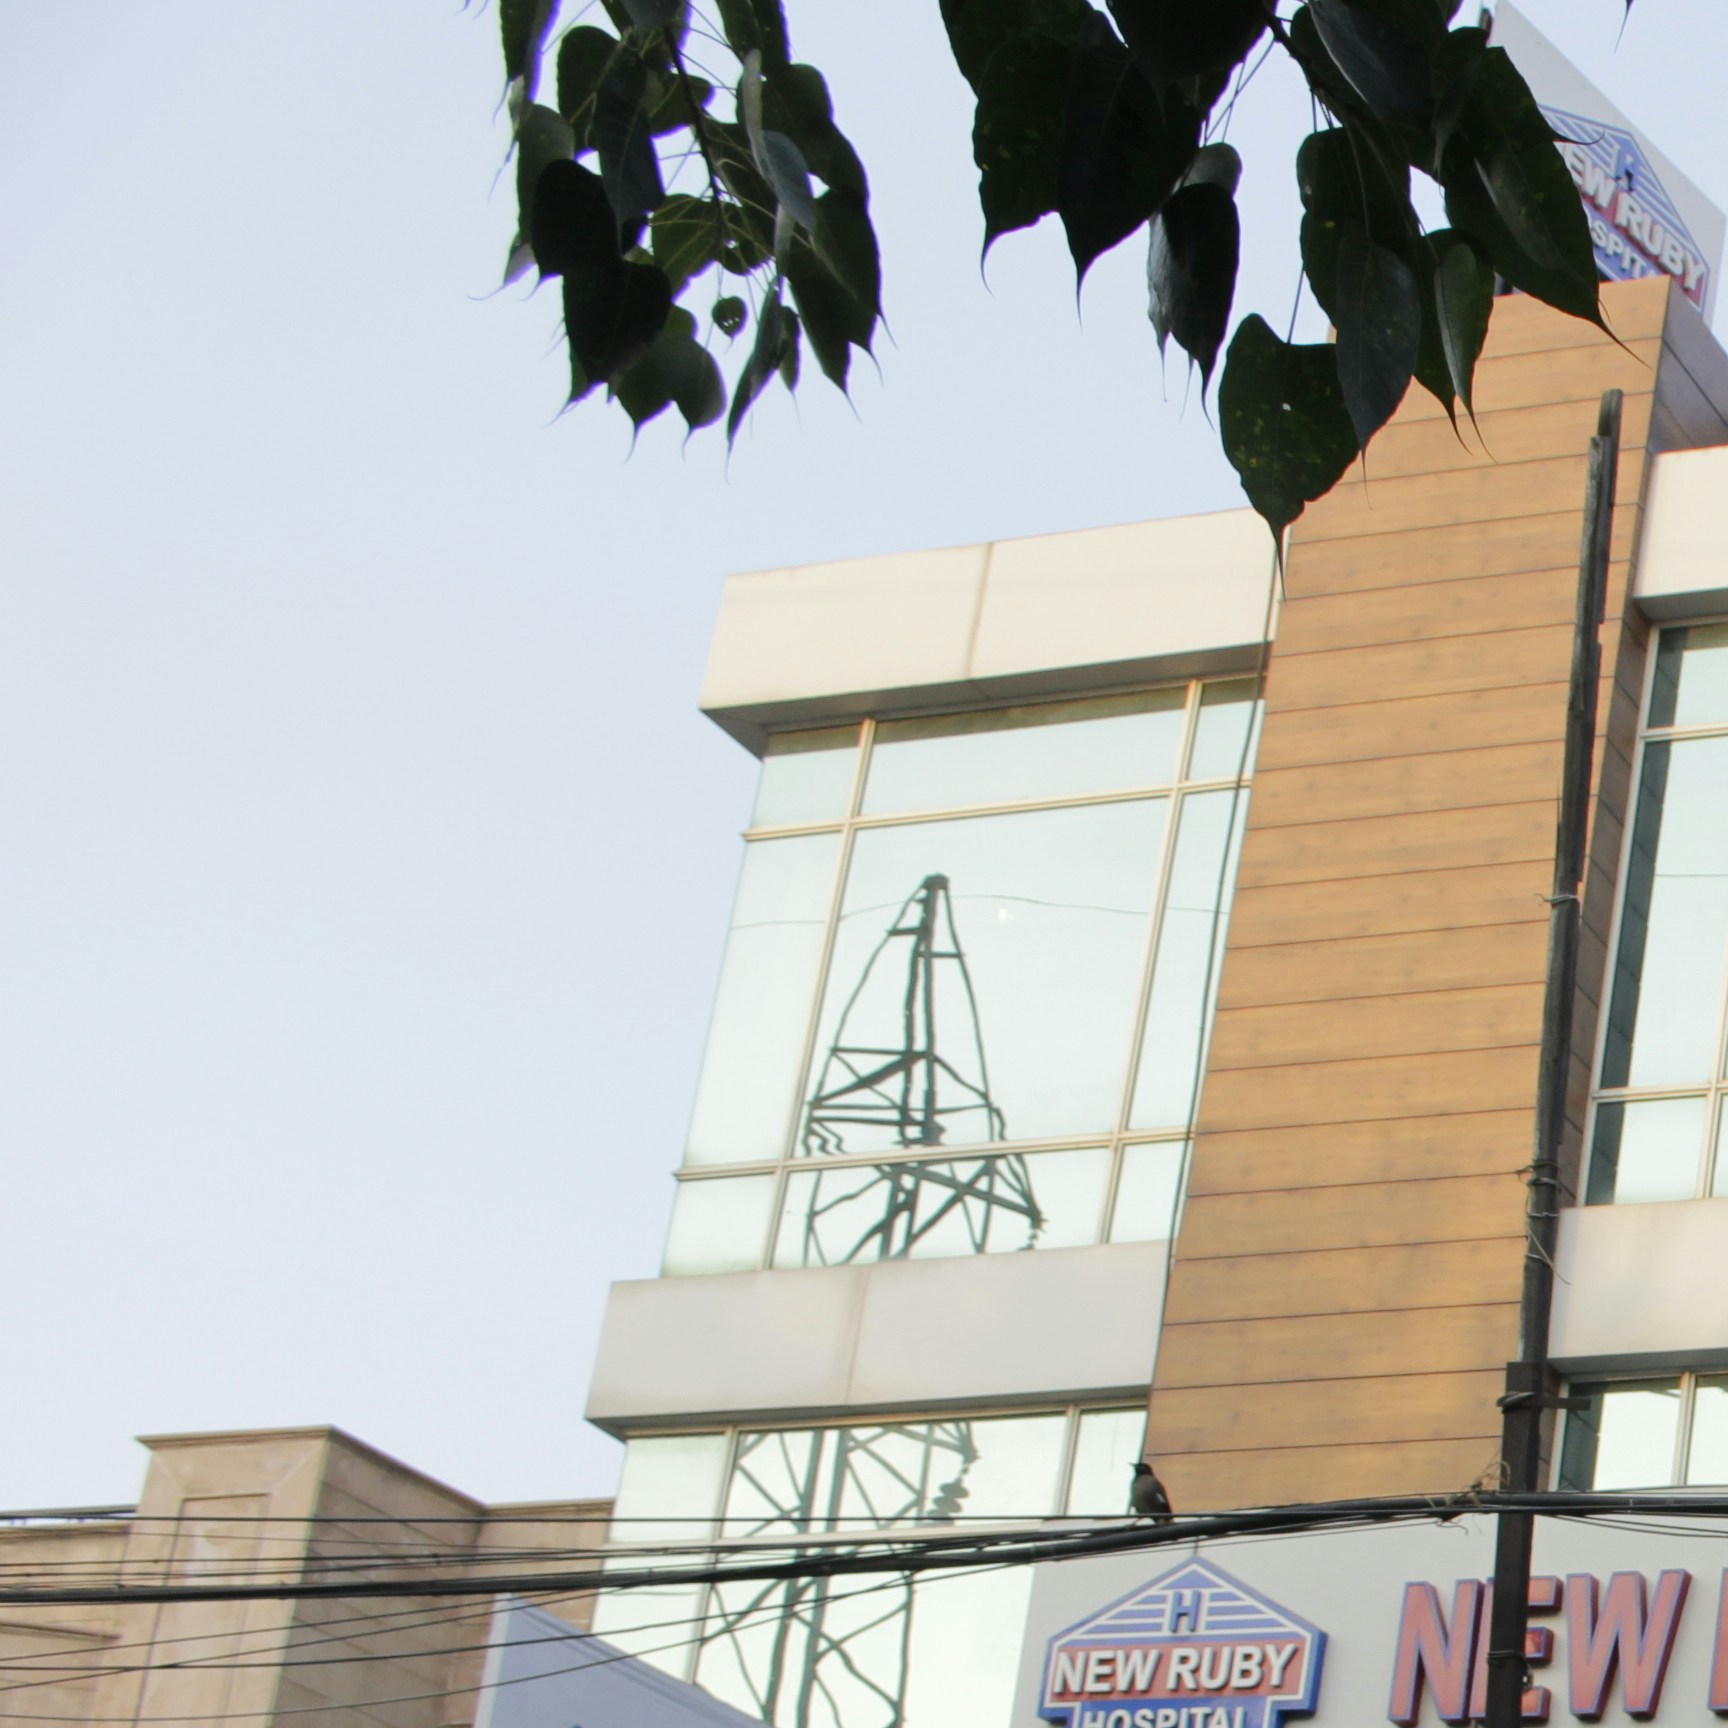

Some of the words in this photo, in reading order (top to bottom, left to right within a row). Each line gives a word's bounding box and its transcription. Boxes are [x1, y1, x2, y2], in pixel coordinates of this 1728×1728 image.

[1615, 191, 1706, 291] RUBY
[1053, 1648, 1160, 1694] NEW
[1167, 1643, 1298, 1690] RUBY
[1387, 1567, 1691, 1728] NEW
